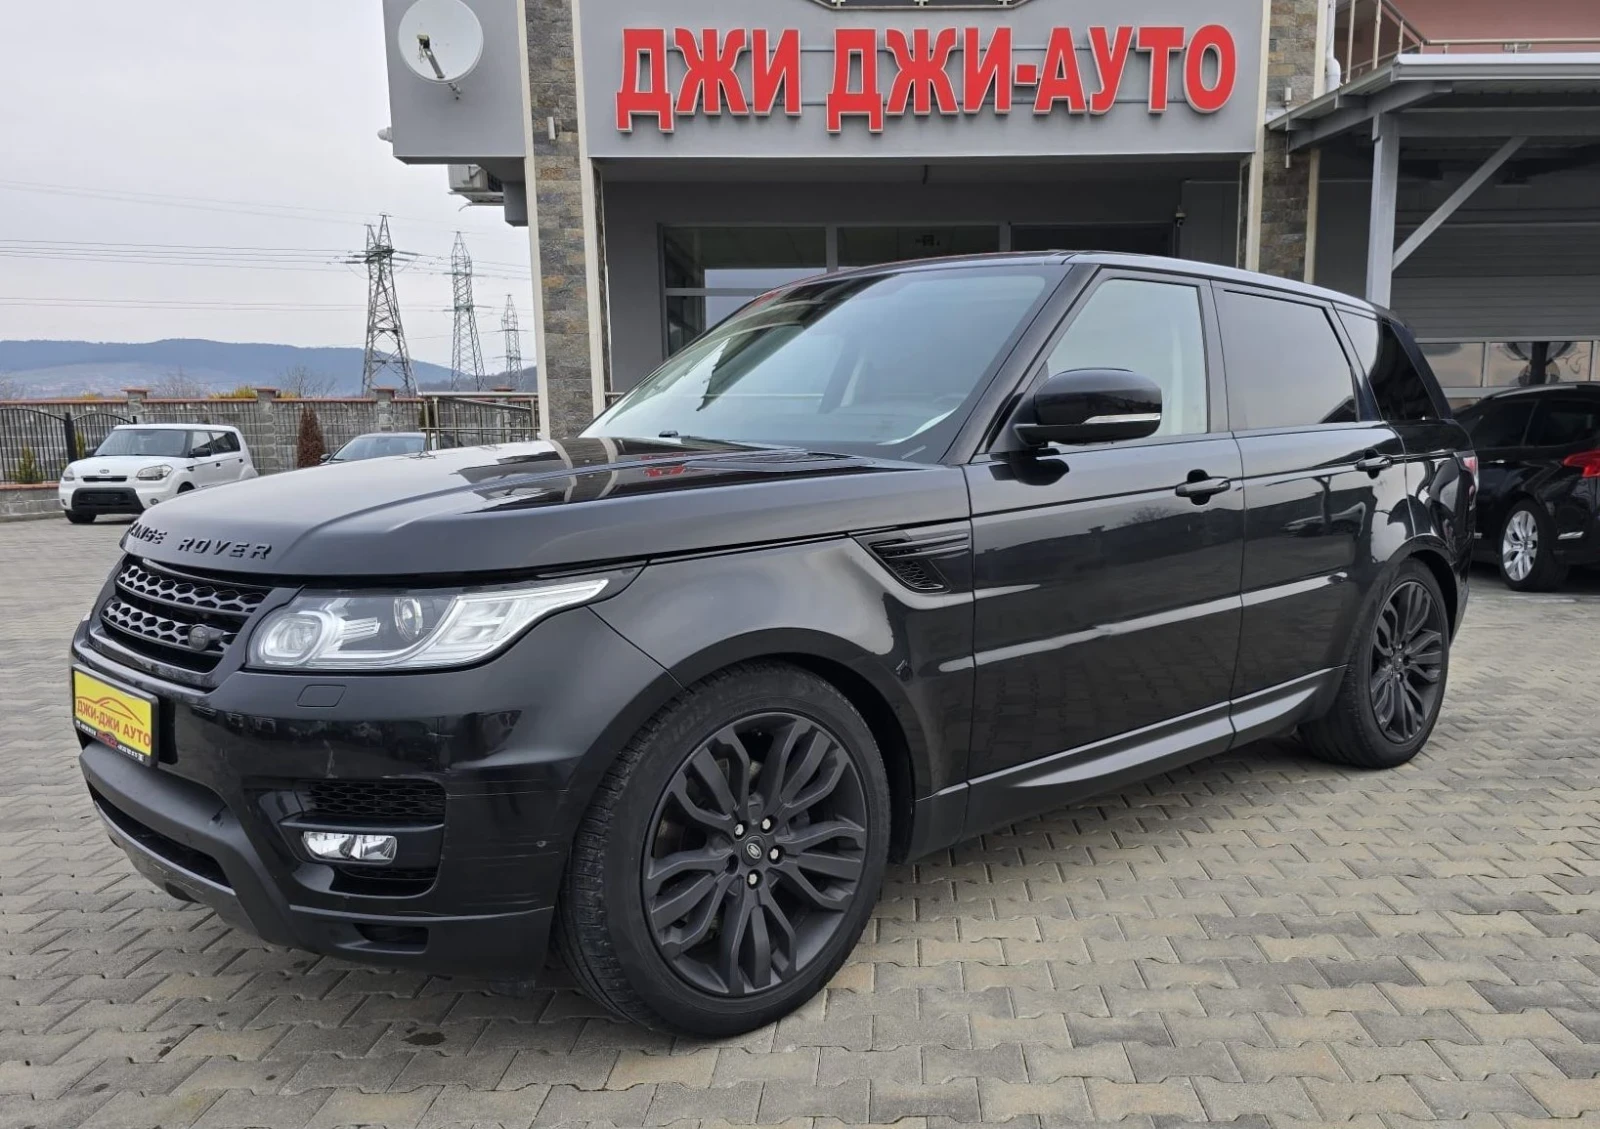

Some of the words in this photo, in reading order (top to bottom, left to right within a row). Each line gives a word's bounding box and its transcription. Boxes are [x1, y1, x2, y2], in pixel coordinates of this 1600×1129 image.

[616, 26, 802, 132] ДЖИ
[826, 23, 1236, 133] ДЖИ-АУТО
[177, 537, 272, 559] ROVER
[76, 700, 121, 733] ДЖИ-ДЖИ
[123, 722, 152, 747] АУТО
